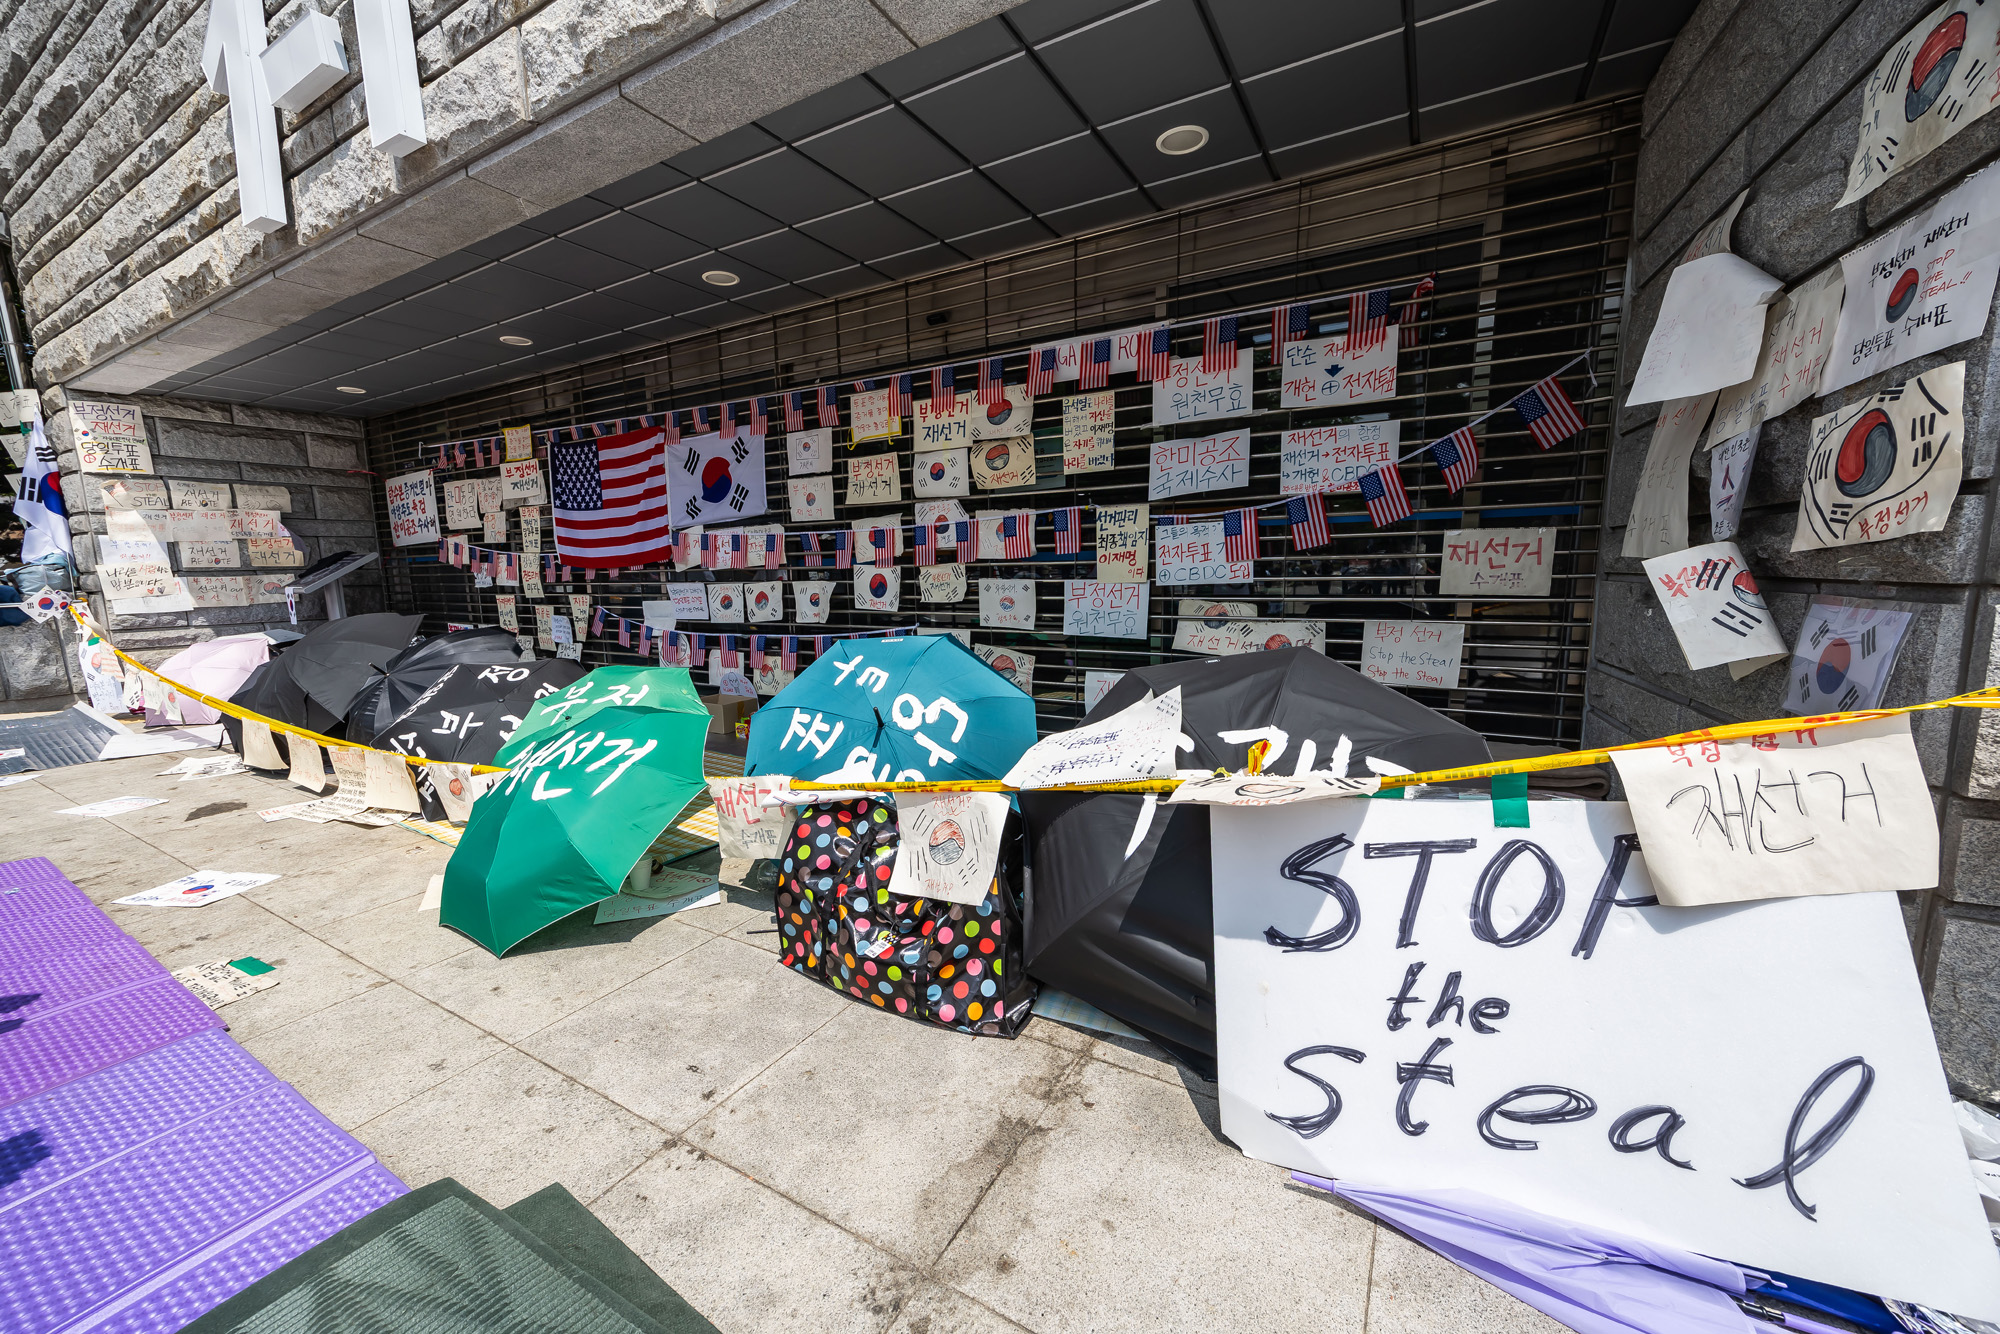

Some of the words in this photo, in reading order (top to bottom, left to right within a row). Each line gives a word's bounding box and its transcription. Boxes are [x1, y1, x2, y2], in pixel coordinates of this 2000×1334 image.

[1868, 245, 1916, 288] 부정선거
[1923, 212, 1970, 248] 재선거
[1926, 248, 1955, 273] STOP
[1922, 270, 1944, 289] THE
[1771, 317, 1824, 368] 재선거
[1852, 328, 1895, 365] 당일투표
[1287, 345, 1317, 367] 단순
[1284, 376, 1317, 402] 개헌
[1342, 365, 1397, 399] 전자투표
[1778, 354, 1822, 398] 수개표
[73, 402, 135, 421] 부정선거
[1094, 394, 1114, 410] 나라를
[1170, 383, 1247, 420] 원천무효
[1089, 409, 1112, 423] 자신을
[90, 421, 135, 437] 재선거
[922, 420, 966, 443] 재선거
[1090, 421, 1114, 435] 이재명
[1358, 425, 1381, 441] 함정
[81, 442, 140, 457] 당일투표
[1073, 436, 1095, 451] 자기를
[1154, 436, 1246, 472] 한미공조
[98, 455, 143, 471] 수개표
[1064, 453, 1088, 469] 나라를
[1283, 449, 1320, 467] 재선거
[1332, 442, 1391, 463] 전자투표
[505, 461, 538, 478] 부정선거
[852, 456, 895, 481] 부정선거
[989, 470, 1019, 485] 재선거
[1292, 467, 1320, 484] 개헌
[134, 482, 165, 492] STOP
[511, 476, 538, 491] 재선거
[852, 476, 892, 498] 재선거
[1153, 463, 1243, 496] 국제수사
[131, 497, 170, 506] STEAL
[411, 498, 426, 516] 특검
[169, 512, 194, 521] 부정선거
[230, 518, 274, 532] 재선거
[1095, 509, 1138, 532] 선거관리
[1857, 491, 1929, 539] 부정선거
[393, 516, 418, 539] 한미공조
[188, 547, 227, 556] 재선거
[251, 551, 296, 565] 재선거
[1099, 550, 1137, 567] 이재명
[1448, 536, 1543, 570] 재선거
[105, 567, 137, 577] 나라를
[1128, 566, 1144, 579] 이다
[1174, 564, 1227, 582] CBDC
[1229, 562, 1251, 580] 도입
[1470, 569, 1527, 589] 수개표
[929, 582, 951, 592] 재선거
[1068, 582, 1141, 610] 부정선거
[1069, 608, 1139, 636] 원천무효
[1375, 621, 1404, 643] 부정
[1410, 625, 1442, 643] 선거
[1187, 634, 1239, 650] 재선거
[1369, 645, 1393, 663] Stop
[1419, 653, 1453, 668] Steal
[1367, 664, 1387, 680] Stop
[1392, 667, 1409, 680] the
[1416, 670, 1443, 686] Steal
[486, 730, 658, 801] 재선거
[713, 782, 786, 825] 재선거
[1665, 762, 1883, 855] 재선거
[1263, 833, 1661, 960] STOP
[1387, 961, 1511, 1035] the
[1264, 1037, 1876, 1223] Steal
